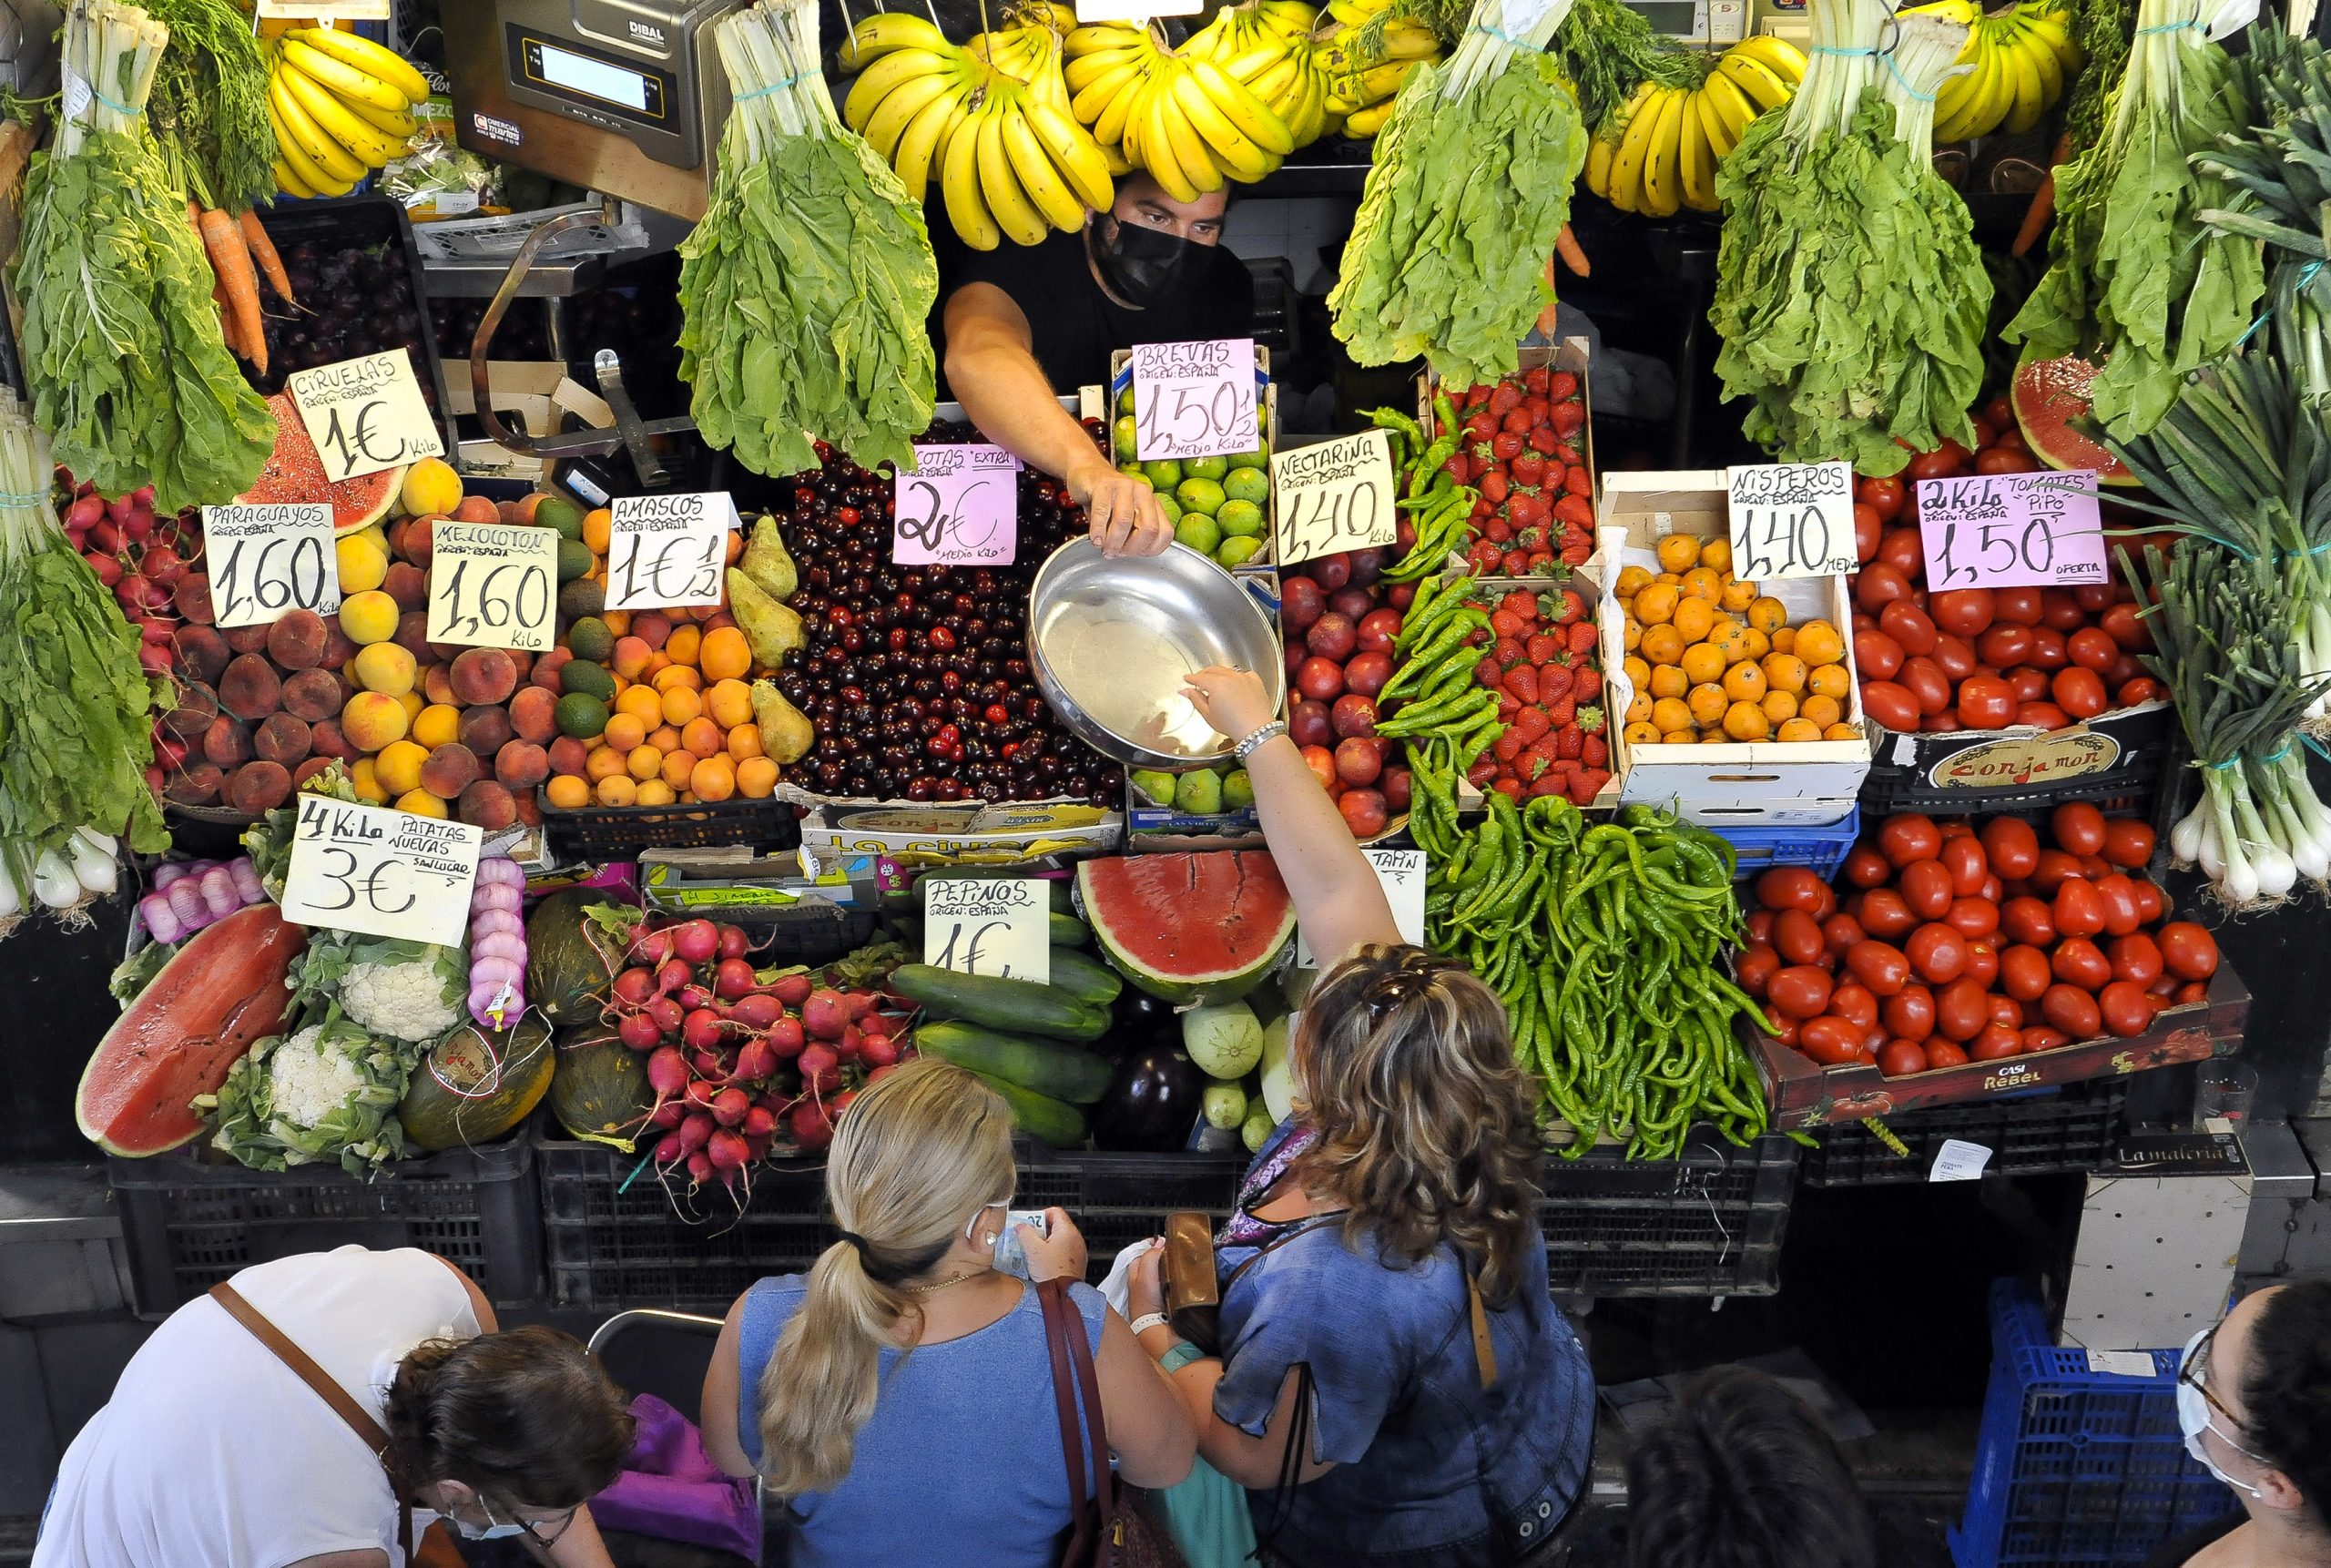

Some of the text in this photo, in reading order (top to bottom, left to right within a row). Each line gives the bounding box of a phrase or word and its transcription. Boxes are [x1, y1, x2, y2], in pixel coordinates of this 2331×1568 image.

[628, 20, 665, 41] DIBAL
[420, 71, 451, 94] Flor
[412, 101, 453, 117] MEZC
[1137, 341, 1229, 367] BREVAS
[1137, 381, 1237, 453] 1,50
[915, 449, 965, 466] COTAS
[209, 505, 324, 525] PARAGUAYOS
[615, 494, 703, 519] AMASCOS
[1280, 481, 1378, 562] 1,40
[436, 525, 550, 549] MELOCOTON
[1734, 504, 1830, 579] 1,40
[1934, 518, 2102, 585] 1,50 OFERTA
[215, 536, 326, 623] 1,60
[438, 560, 548, 637] 1,60
[300, 800, 331, 839] 4
[401, 815, 467, 841] PATATAS
[388, 836, 452, 855] NUEVAS
[412, 857, 472, 875] SANLUCAR
[300, 848, 416, 913] 3€
[1999, 1064, 2026, 1076] CASI
